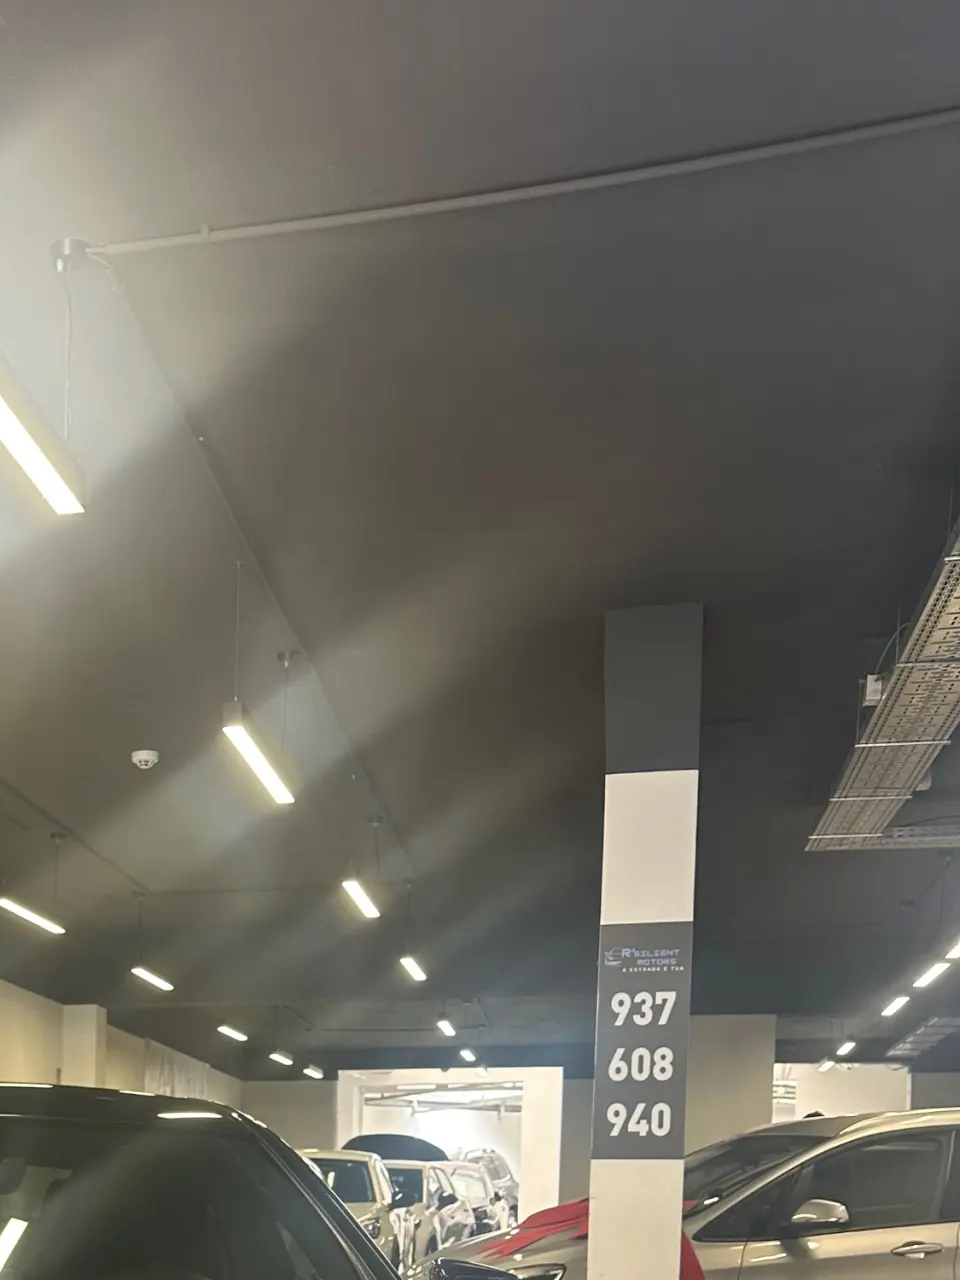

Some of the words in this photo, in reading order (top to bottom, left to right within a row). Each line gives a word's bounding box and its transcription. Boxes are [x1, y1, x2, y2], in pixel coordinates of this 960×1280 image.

[611, 991, 677, 1026] 937
[608, 1046, 674, 1081] 608
[606, 1102, 672, 1137] 940
